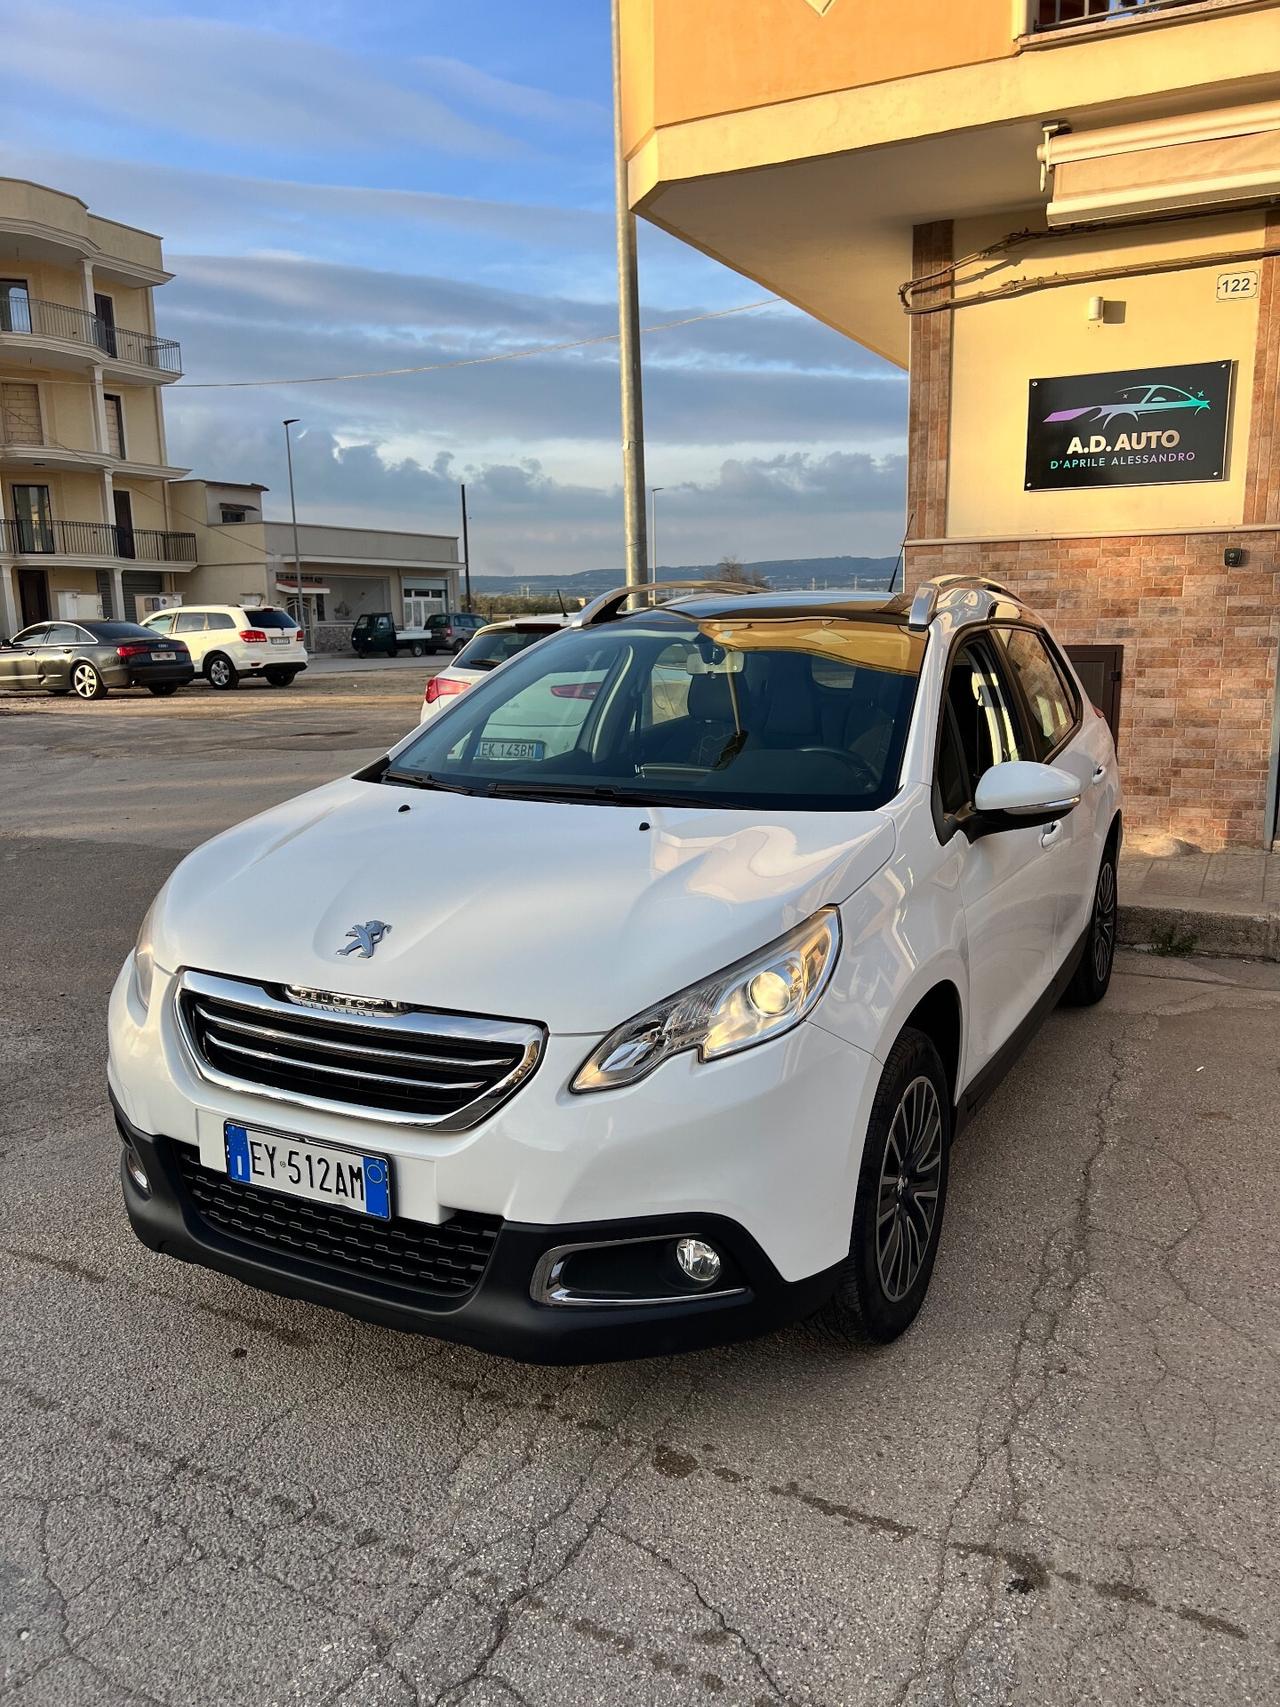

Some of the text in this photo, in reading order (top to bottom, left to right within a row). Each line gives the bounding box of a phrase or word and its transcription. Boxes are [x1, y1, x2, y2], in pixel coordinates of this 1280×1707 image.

[1222, 278, 1250, 292] 122
[1066, 430, 1180, 454] A.D. AUTO
[1050, 452, 1195, 469] D'APRILE ALESSANDRO
[482, 743, 495, 756] EK
[250, 1140, 364, 1201] EY 512AM
